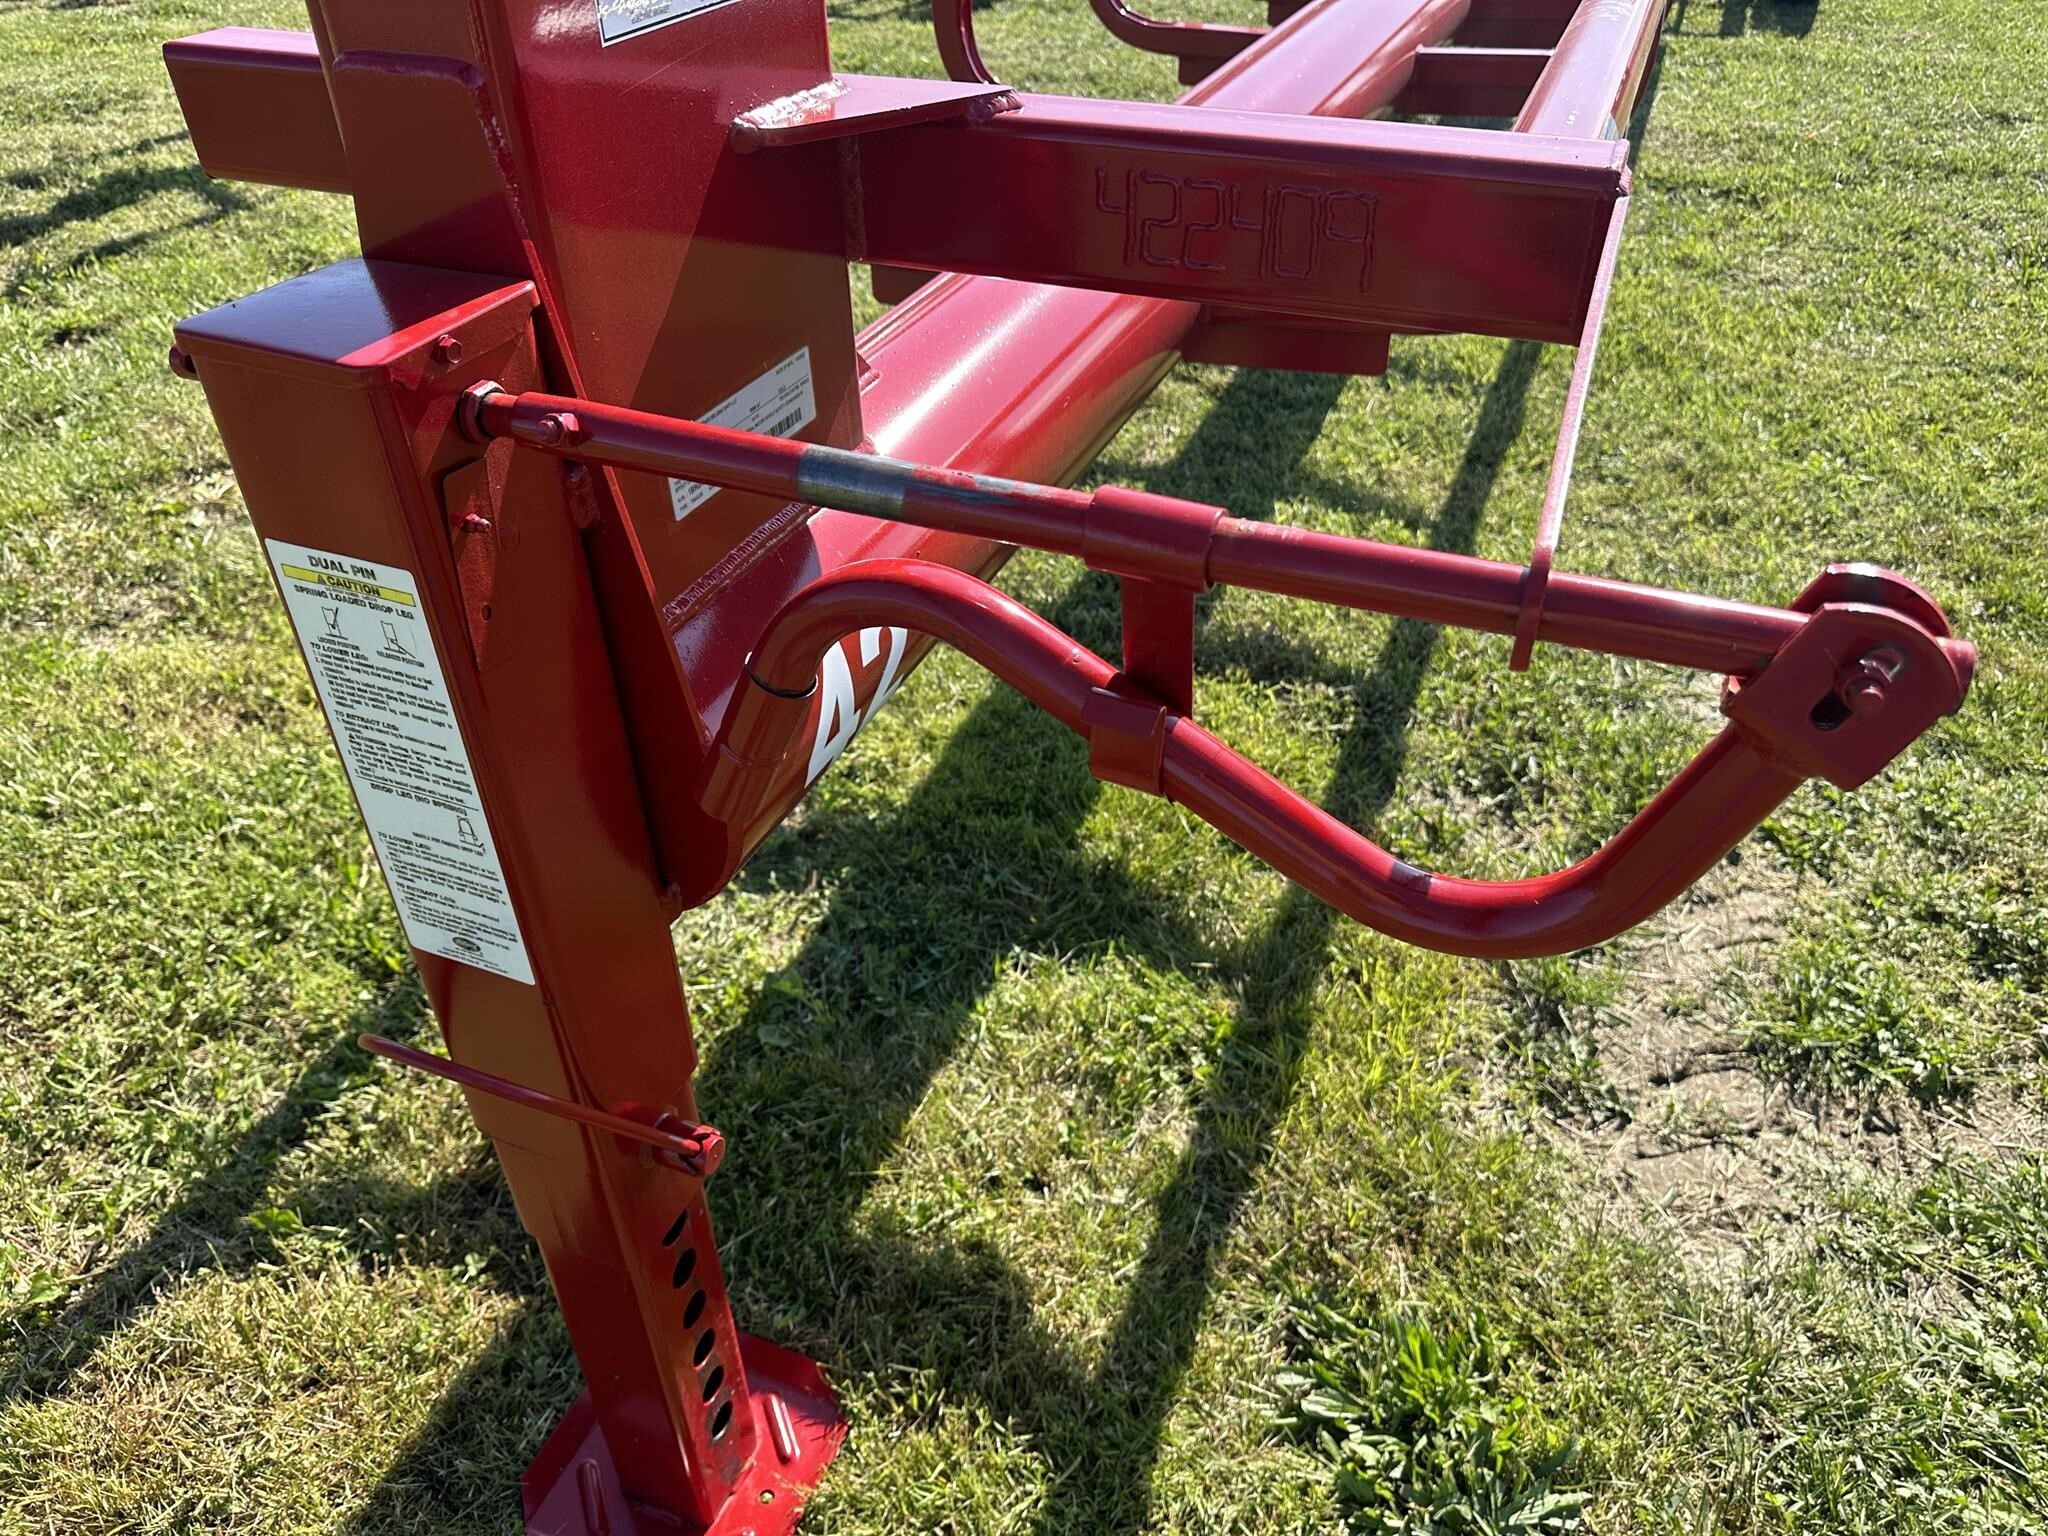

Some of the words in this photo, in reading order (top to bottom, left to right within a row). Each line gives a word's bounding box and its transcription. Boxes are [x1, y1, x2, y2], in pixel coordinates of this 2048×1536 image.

[1096, 168, 1378, 293] 422409
[307, 554, 349, 574] DUAL
[350, 564, 376, 581] PIN
[326, 576, 381, 596] CAUTION
[293, 584, 328, 598] SPRING
[329, 592, 367, 608] LOADED
[368, 601, 394, 614] DROP
[395, 608, 414, 619] LEG
[310, 642, 321, 650] TO
[321, 645, 350, 657] LOWER
[334, 709, 344, 717] TO
